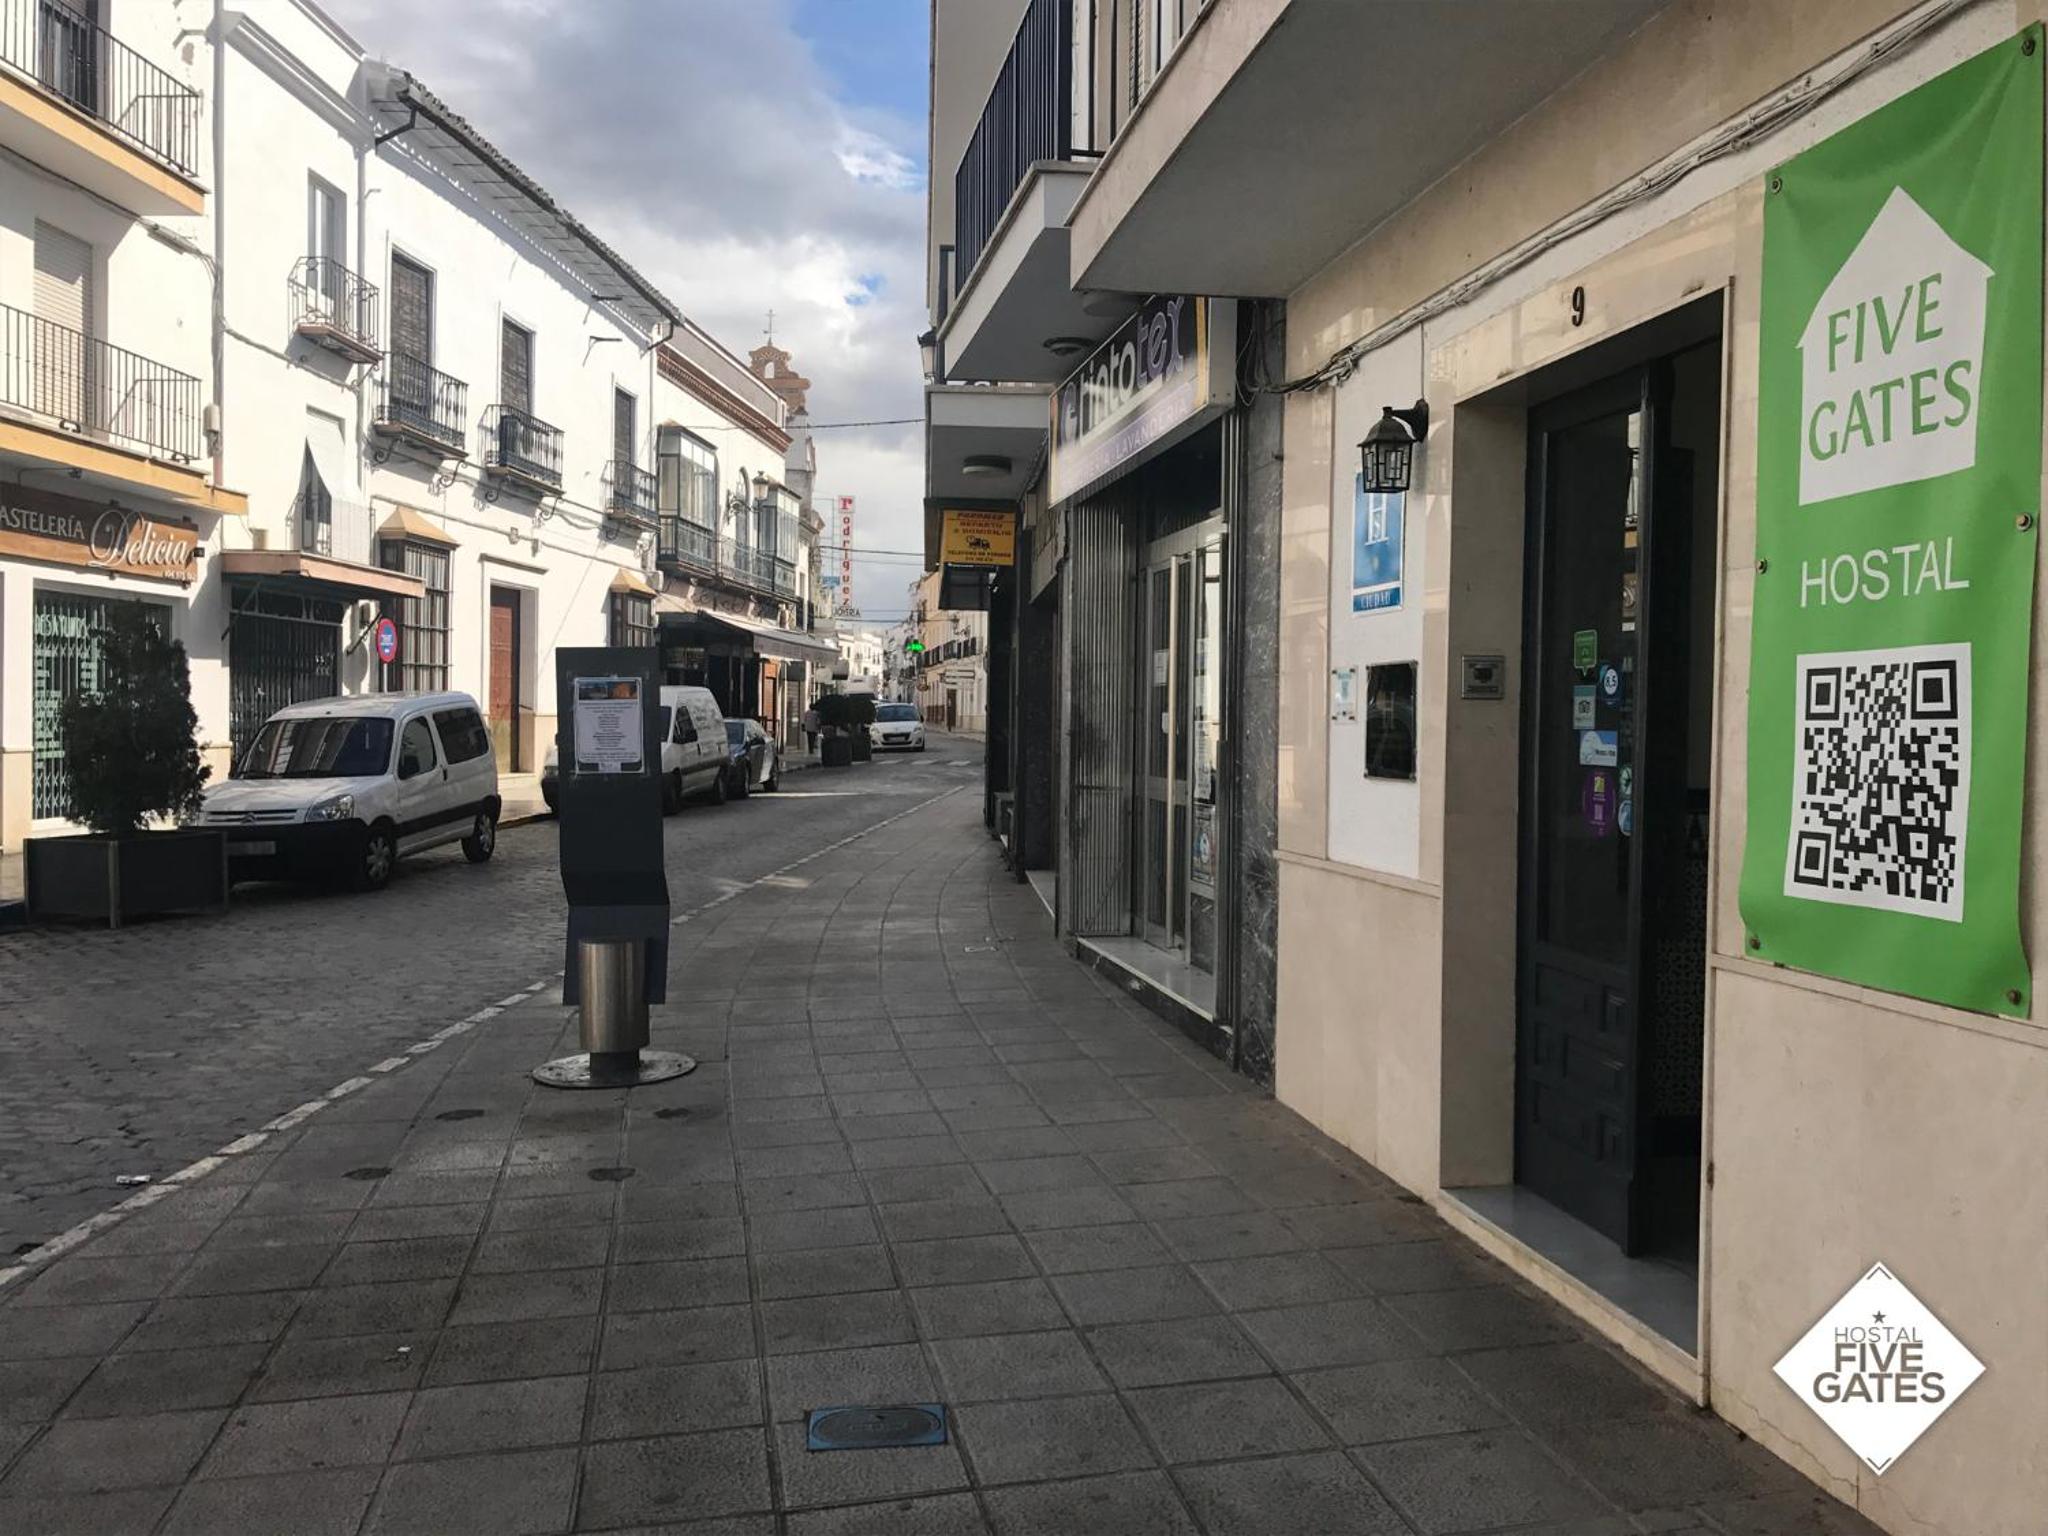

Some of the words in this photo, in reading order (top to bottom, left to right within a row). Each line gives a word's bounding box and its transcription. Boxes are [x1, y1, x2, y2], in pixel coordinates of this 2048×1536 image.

[1571, 286, 1584, 327] 9
[1828, 272, 1943, 373] FIVE
[1808, 360, 1972, 461] GATES
[0, 505, 85, 540] ASTELERÍA
[88, 509, 188, 570] Delicia
[1801, 536, 1970, 608] HOSTAL
